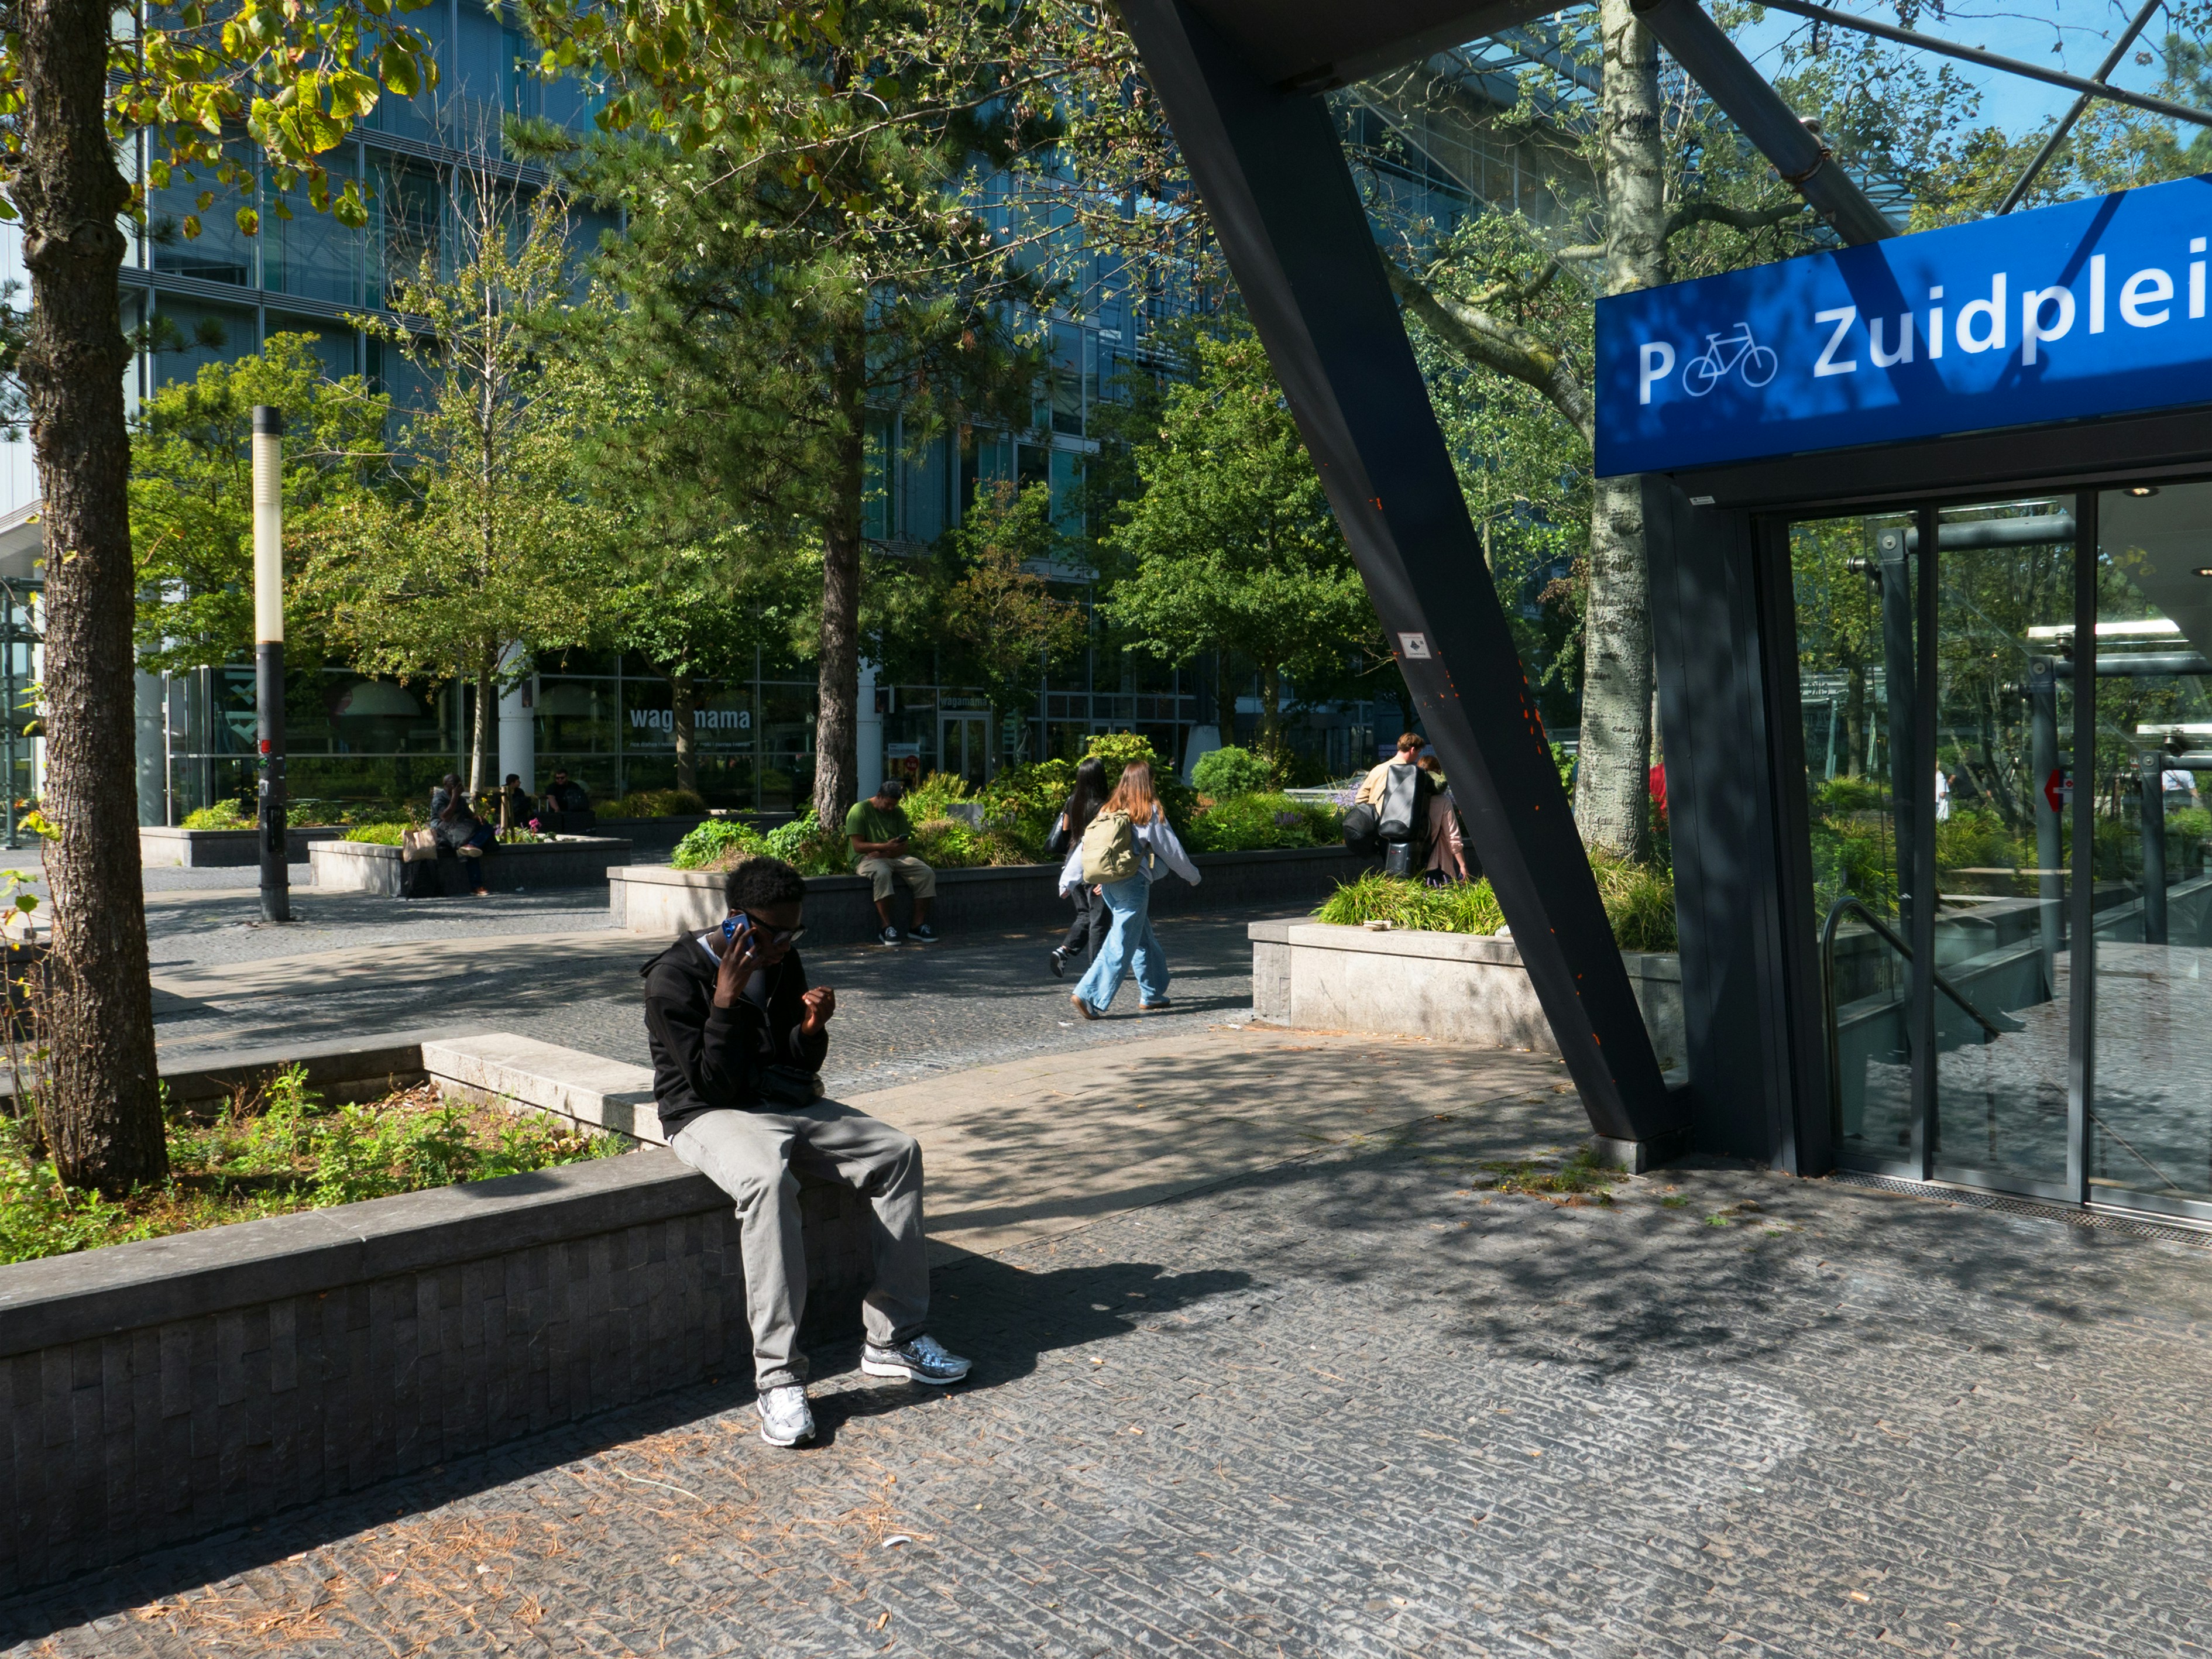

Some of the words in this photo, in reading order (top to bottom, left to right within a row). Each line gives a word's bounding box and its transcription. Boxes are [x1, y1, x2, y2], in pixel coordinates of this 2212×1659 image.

[1639, 341, 1675, 405] P
[1814, 236, 2207, 377] Zuidplei
[940, 697, 987, 708] wagamama
[630, 709, 750, 733] wagmama
